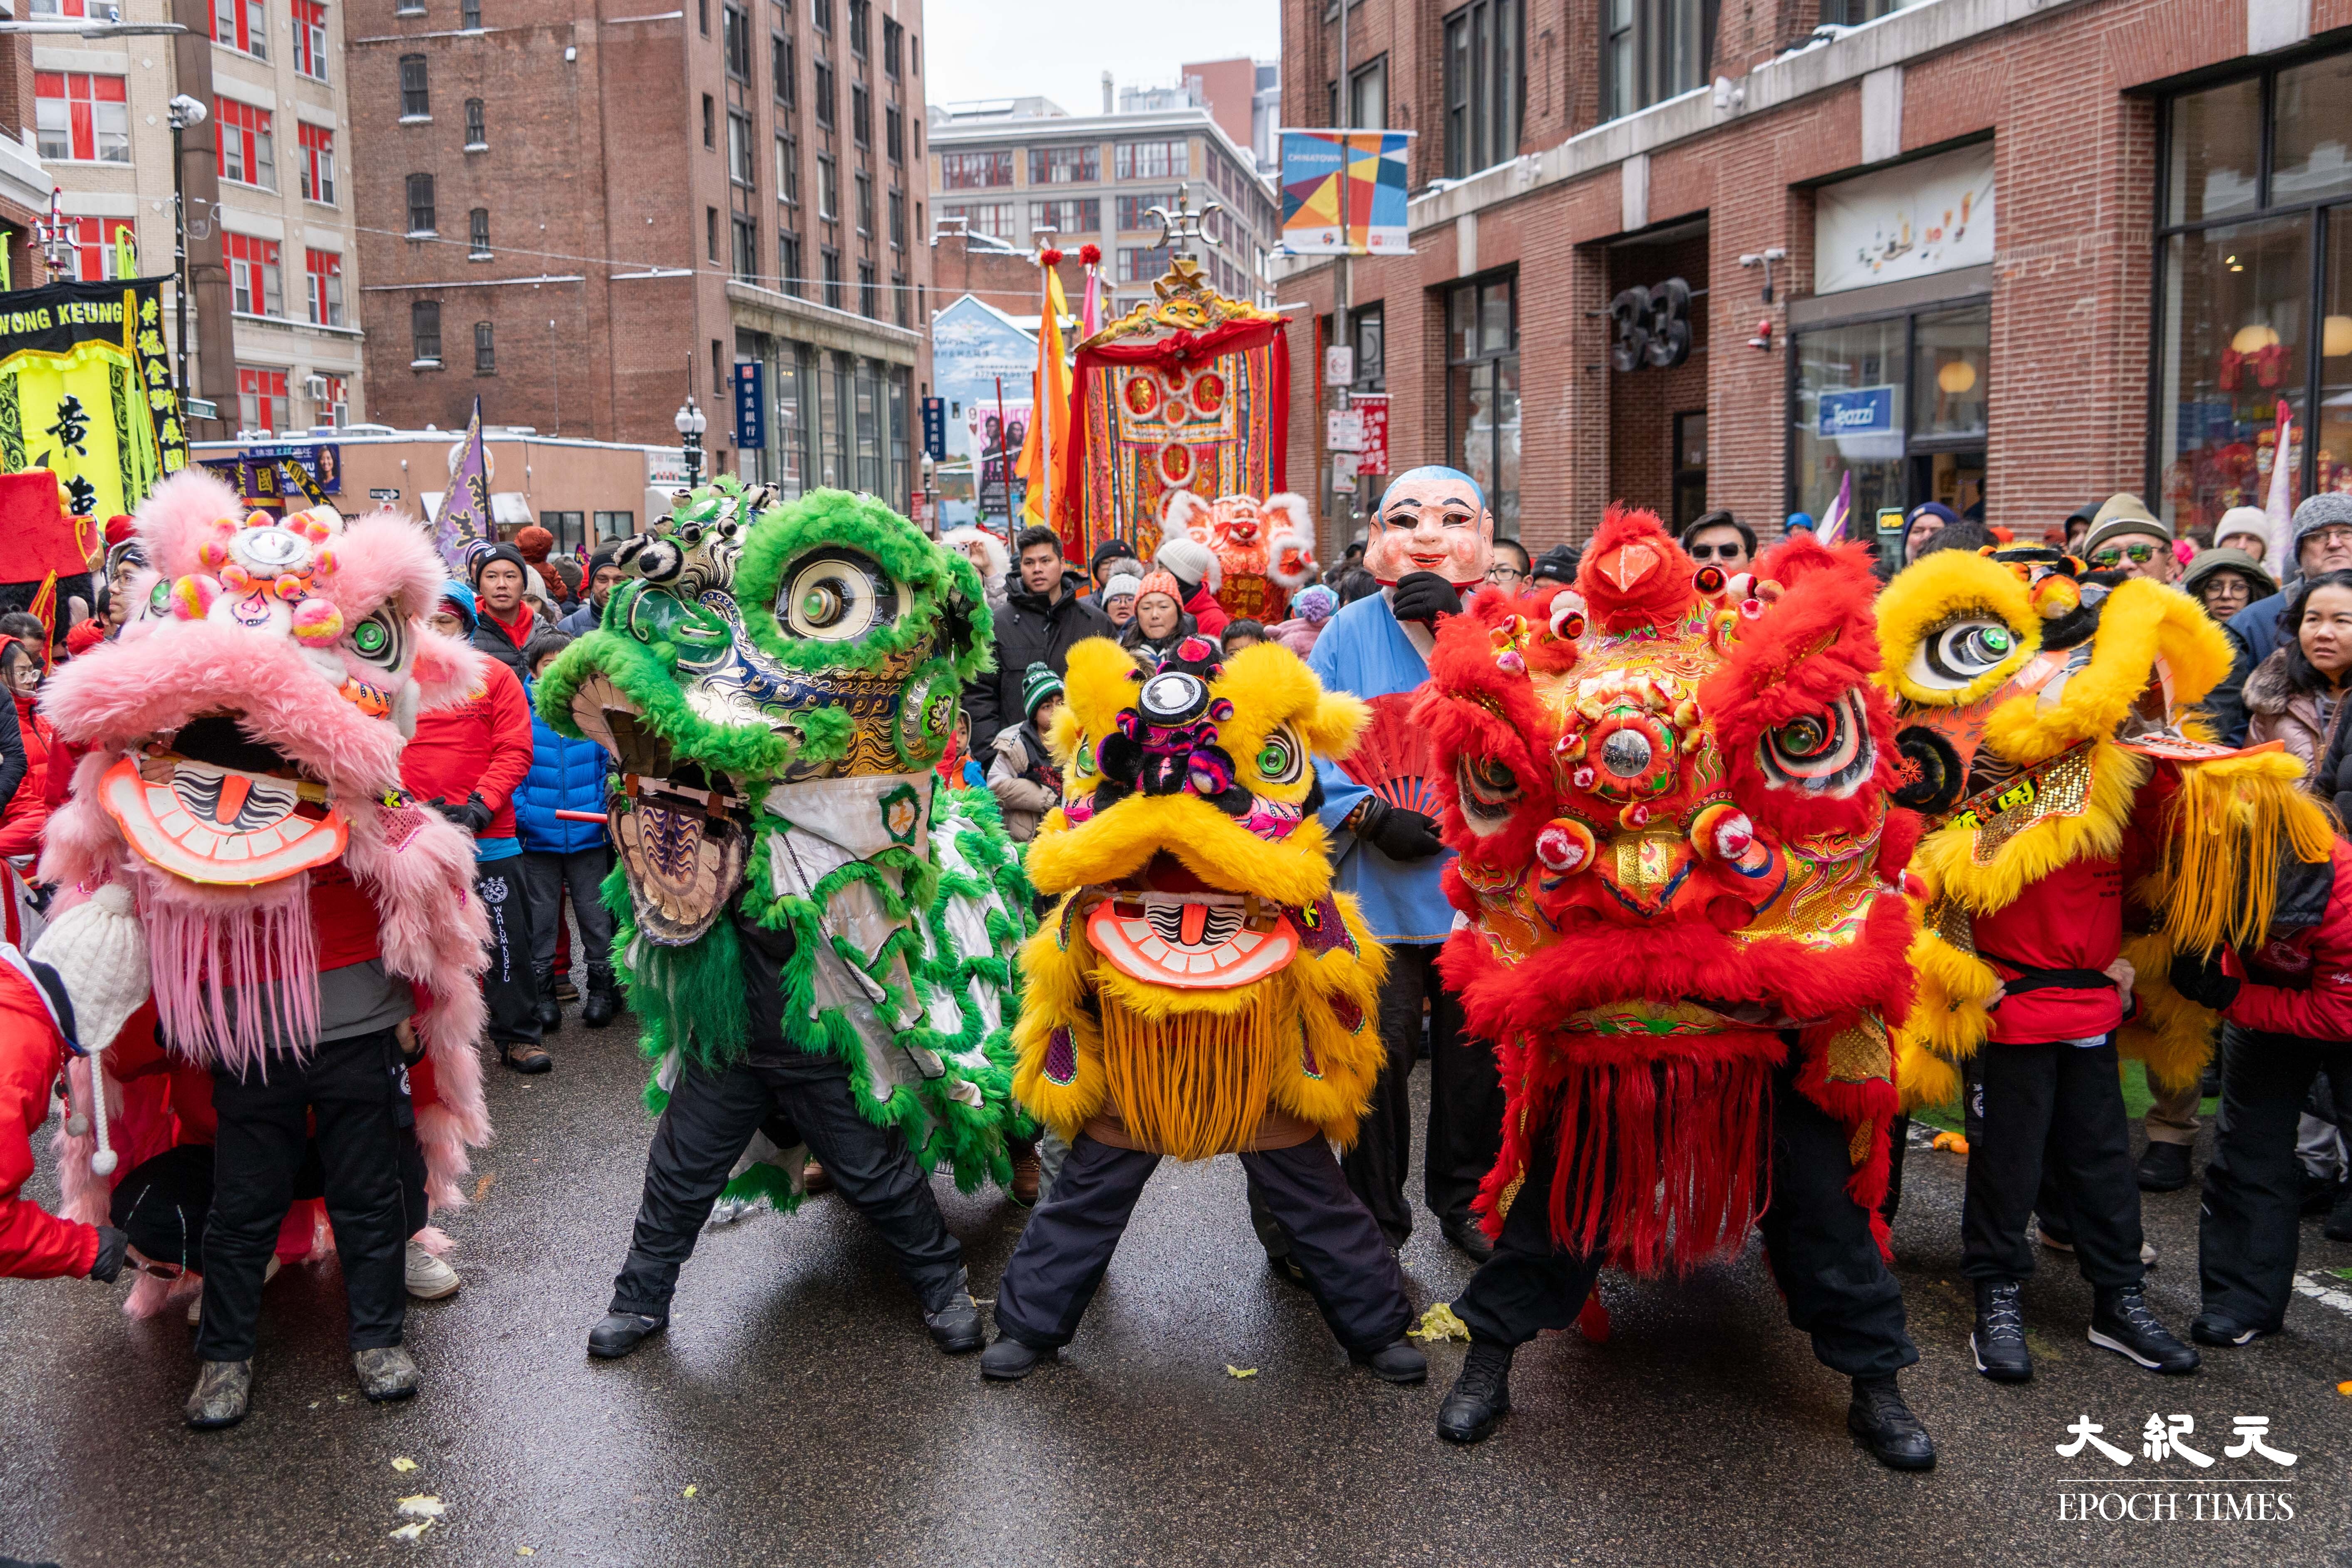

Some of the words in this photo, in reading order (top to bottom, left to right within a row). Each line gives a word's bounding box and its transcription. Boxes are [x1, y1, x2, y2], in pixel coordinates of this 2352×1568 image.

[57, 301, 123, 325] KEUNG
[1610, 277, 1691, 372] 33
[744, 382, 756, 437] 華美銀行
[494, 905, 504, 925] WAH
[499, 925, 509, 944] LUM
[504, 970, 510, 982] FU
